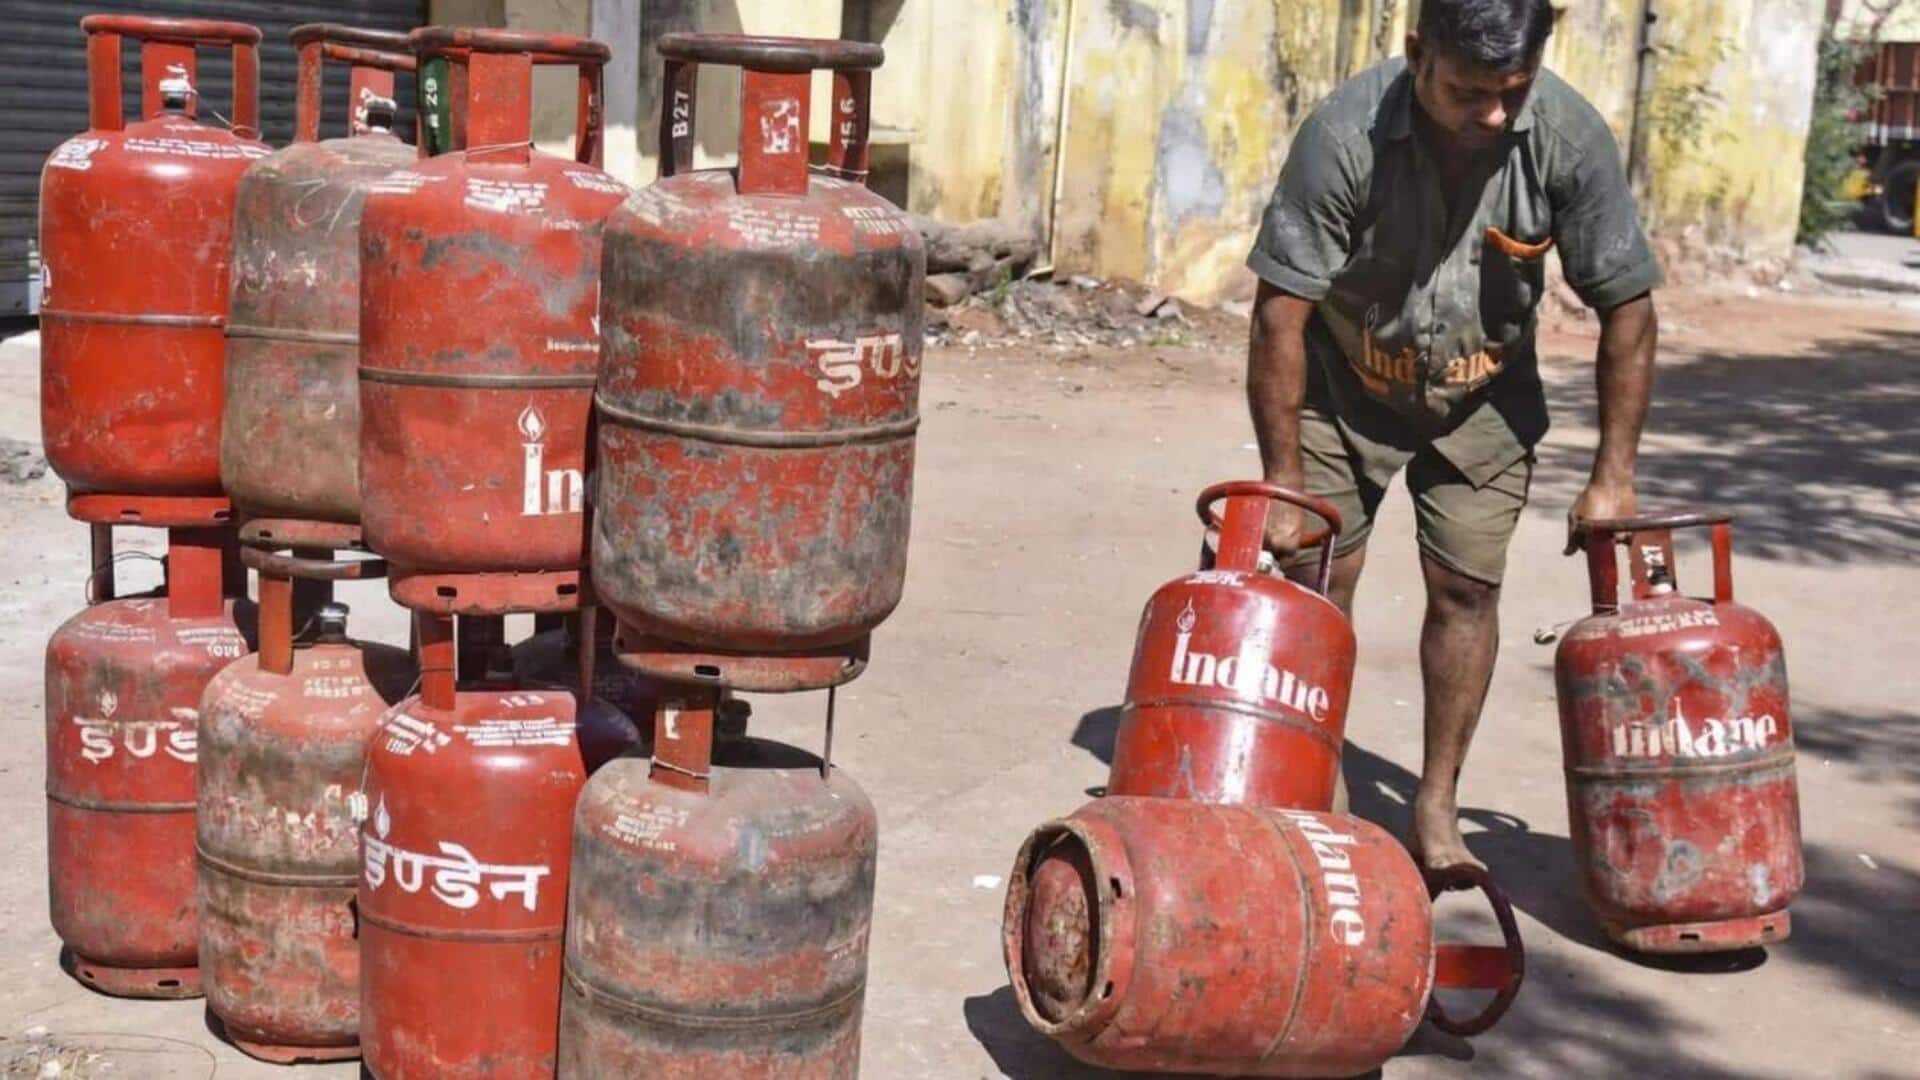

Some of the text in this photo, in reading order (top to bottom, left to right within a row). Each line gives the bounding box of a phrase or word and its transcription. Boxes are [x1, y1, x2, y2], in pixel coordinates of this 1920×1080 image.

[672, 90, 690, 138] B27
[1170, 632, 1330, 722] Indane
[362, 832, 551, 911] इण्डेन
